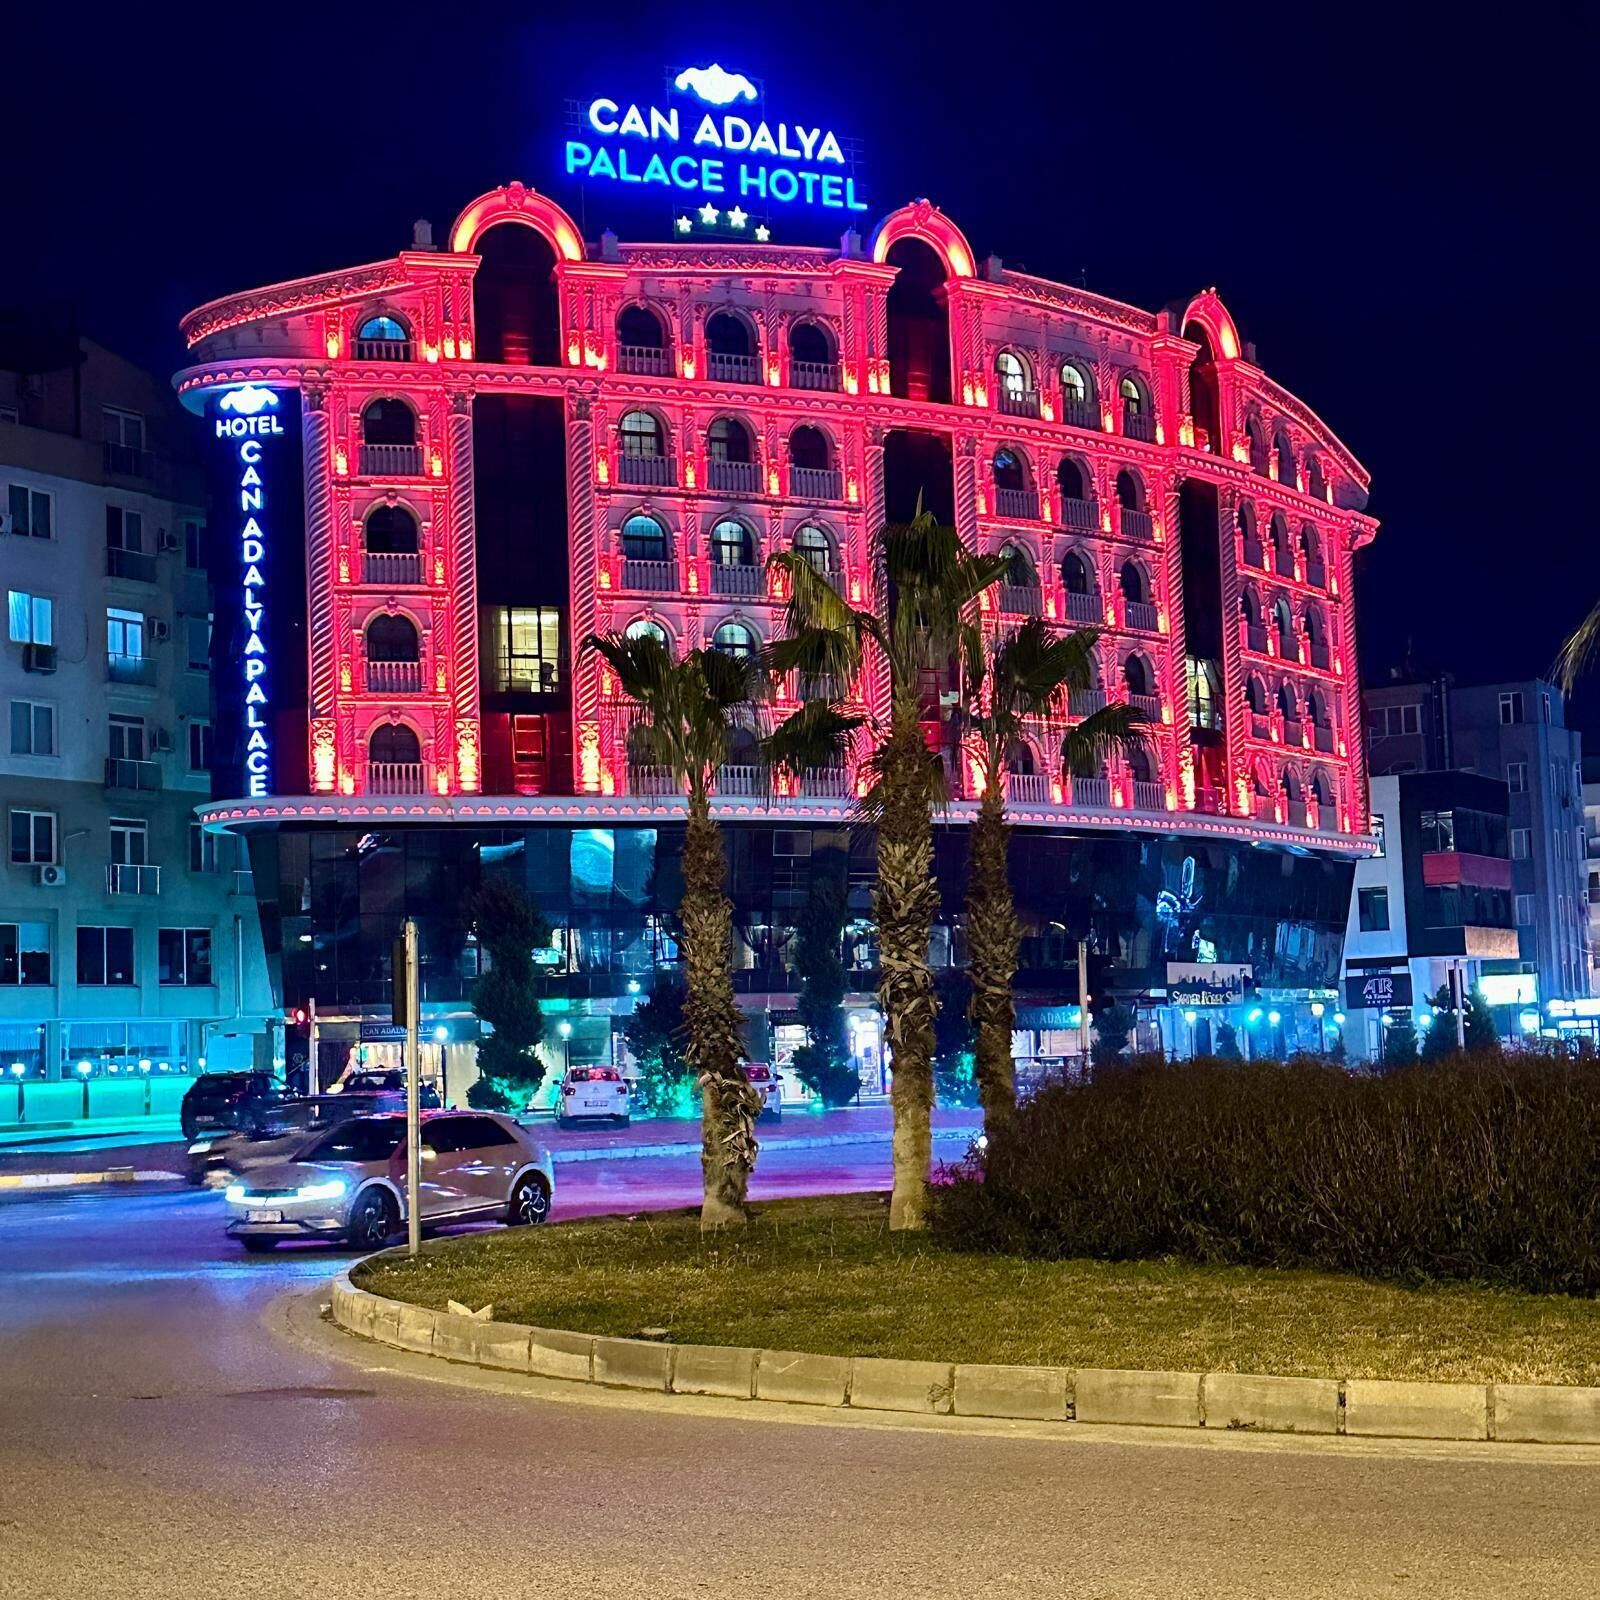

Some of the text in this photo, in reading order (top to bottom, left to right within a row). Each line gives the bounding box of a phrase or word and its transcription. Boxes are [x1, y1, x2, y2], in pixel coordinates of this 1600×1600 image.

[588, 98, 845, 164] CAN ADALYA
[565, 141, 868, 211] PALACE HOTEL
[216, 415, 284, 438] HOTEL
[240, 440, 269, 799] CAN ADALYA PALACE
